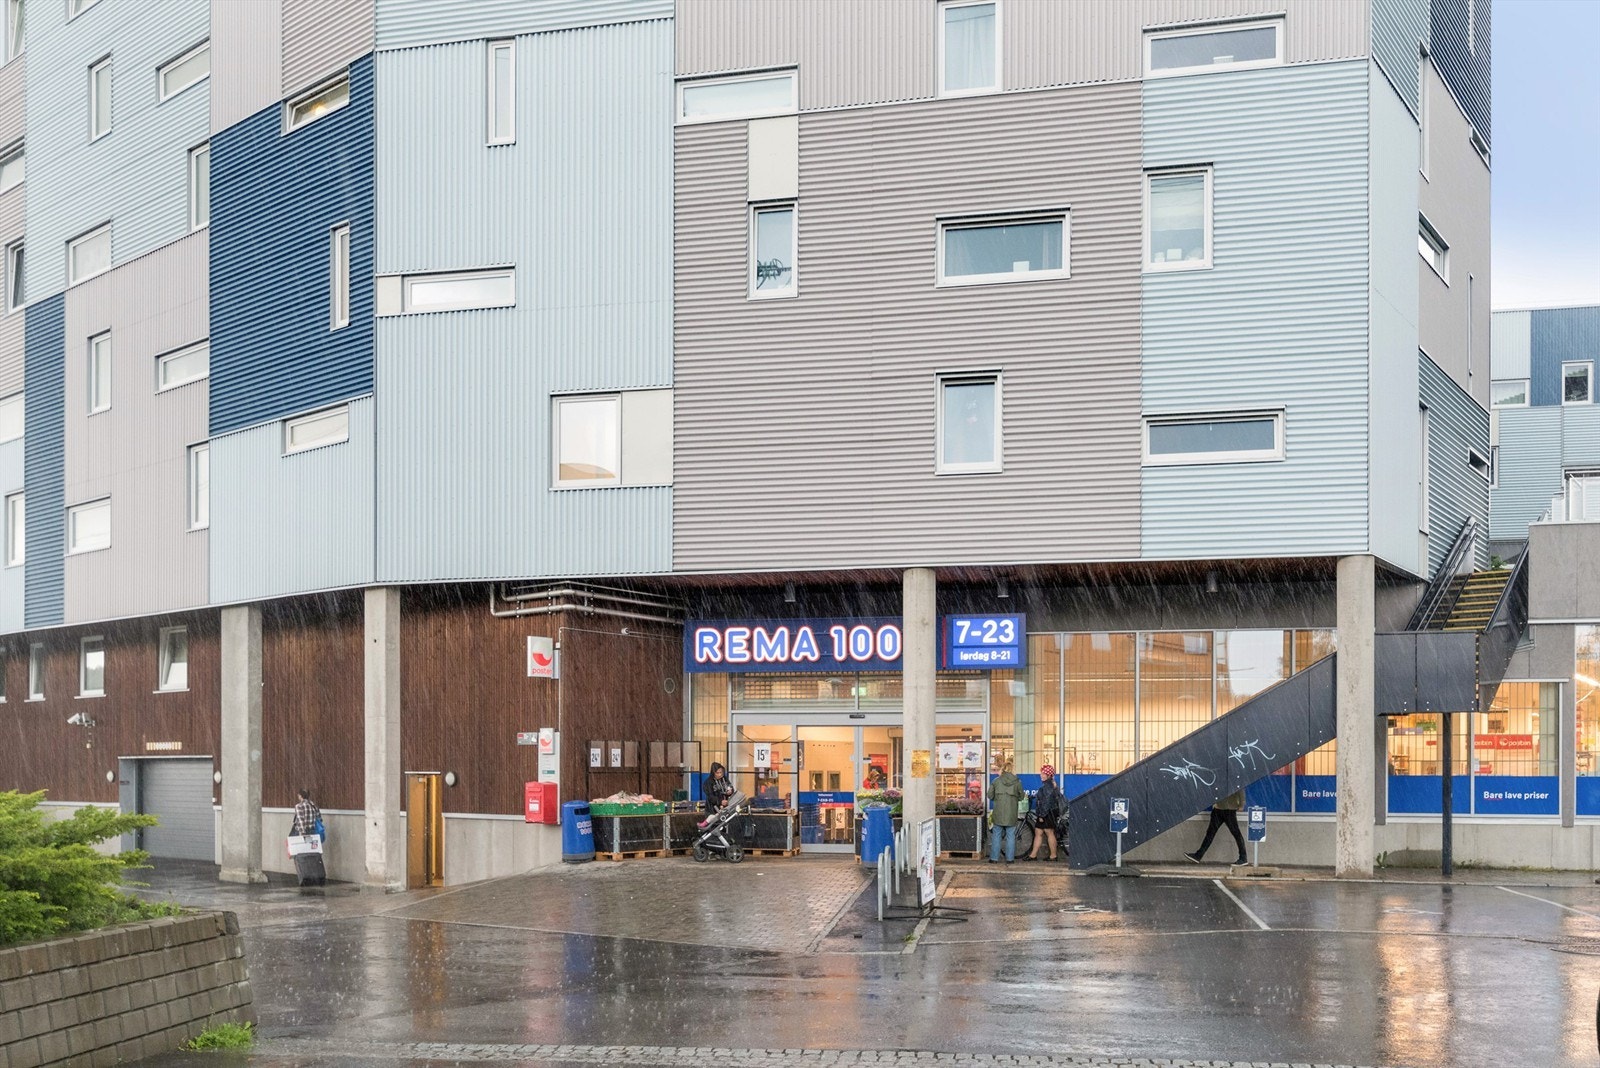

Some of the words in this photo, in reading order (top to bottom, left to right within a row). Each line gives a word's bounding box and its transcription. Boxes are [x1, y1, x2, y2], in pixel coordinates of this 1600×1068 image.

[956, 619, 1015, 644] 7-23
[695, 626, 820, 662] REMA
[960, 651, 989, 662] lørdag
[990, 650, 1011, 660] 8-21
[1302, 789, 1321, 798] Bare
[1483, 791, 1503, 799] Bare
[1504, 791, 1522, 799] lave
[1524, 791, 1549, 800] priser
